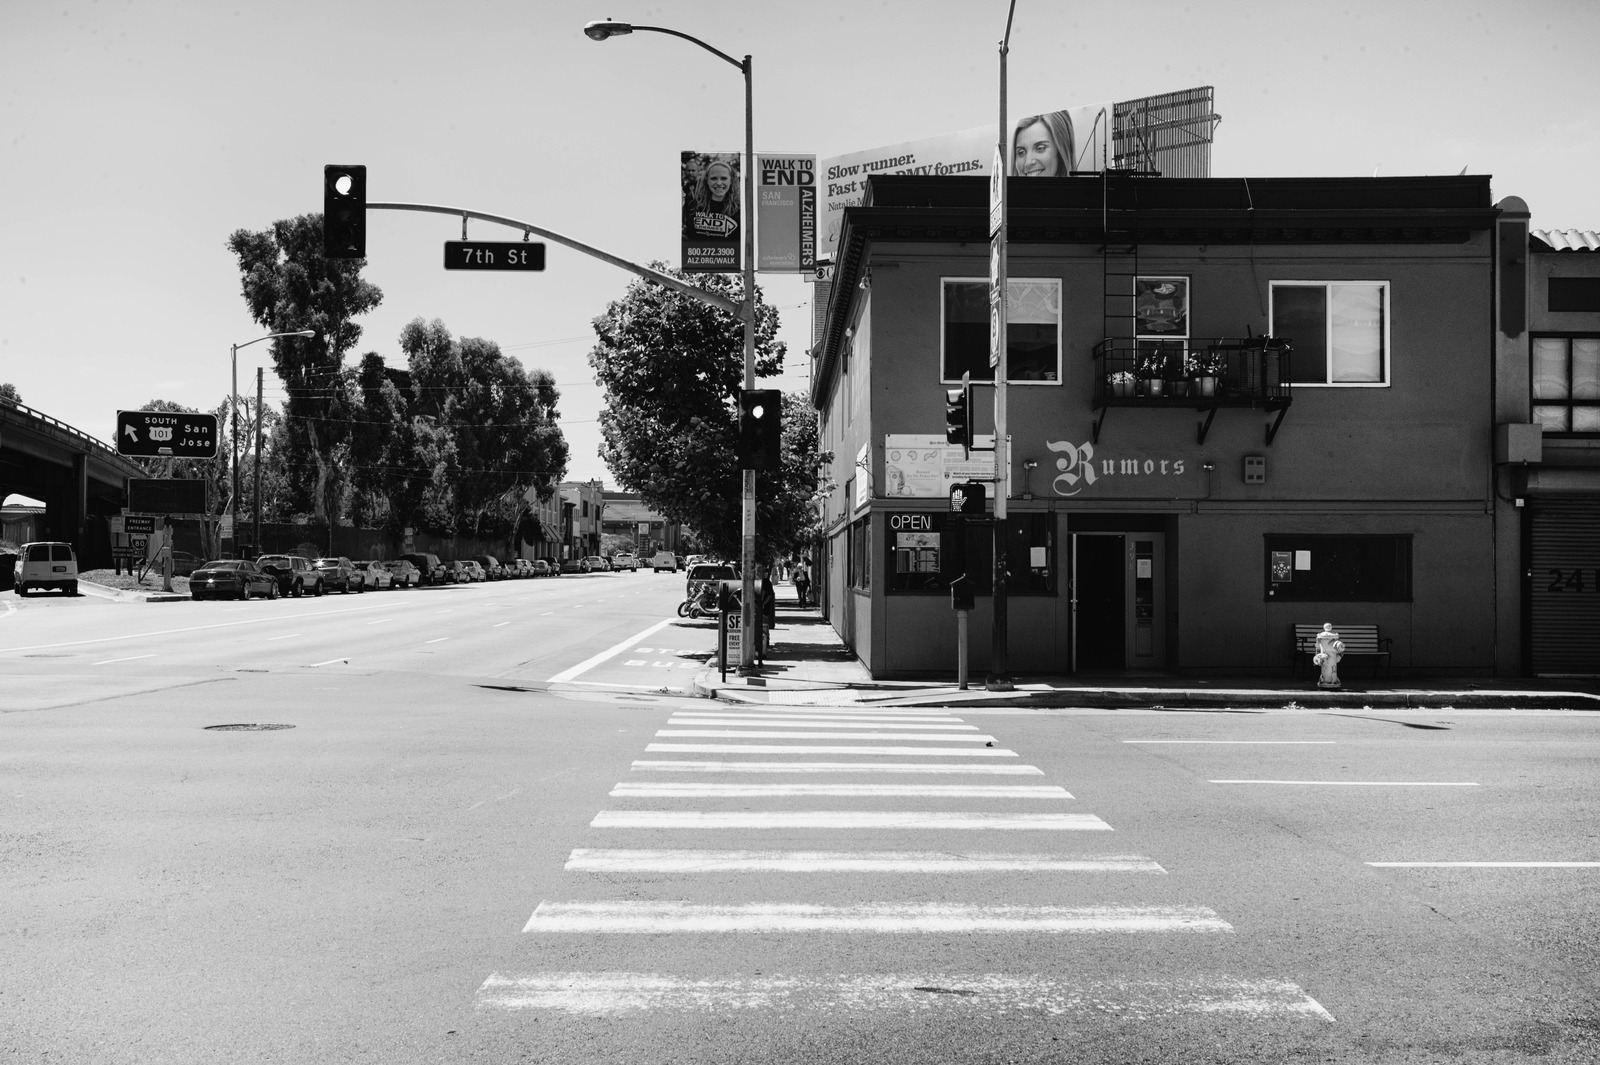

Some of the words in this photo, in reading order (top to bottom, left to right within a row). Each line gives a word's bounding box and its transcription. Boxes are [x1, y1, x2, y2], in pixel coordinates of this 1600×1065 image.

[761, 159, 795, 170] WALK
[798, 159, 813, 170] TO
[828, 165, 860, 181] Slow
[862, 154, 916, 173] runner.
[762, 170, 814, 186] END
[828, 179, 857, 197] Fast
[934, 159, 983, 176] forms.
[762, 191, 781, 200] SAN
[695, 218, 724, 227] END
[802, 189, 814, 266] ALZHEIMER'S
[463, 248, 494, 264] 7th
[507, 248, 528, 265] St
[687, 247, 735, 256] 800.272.3900
[687, 257, 735, 265] ALZ.ORG/WALK
[144, 416, 178, 425] SOUTH
[154, 430, 168, 438] 101
[184, 424, 208, 434] San
[179, 437, 211, 447] Jose
[1046, 440, 1185, 496] Rumors
[890, 515, 931, 530] OPEN
